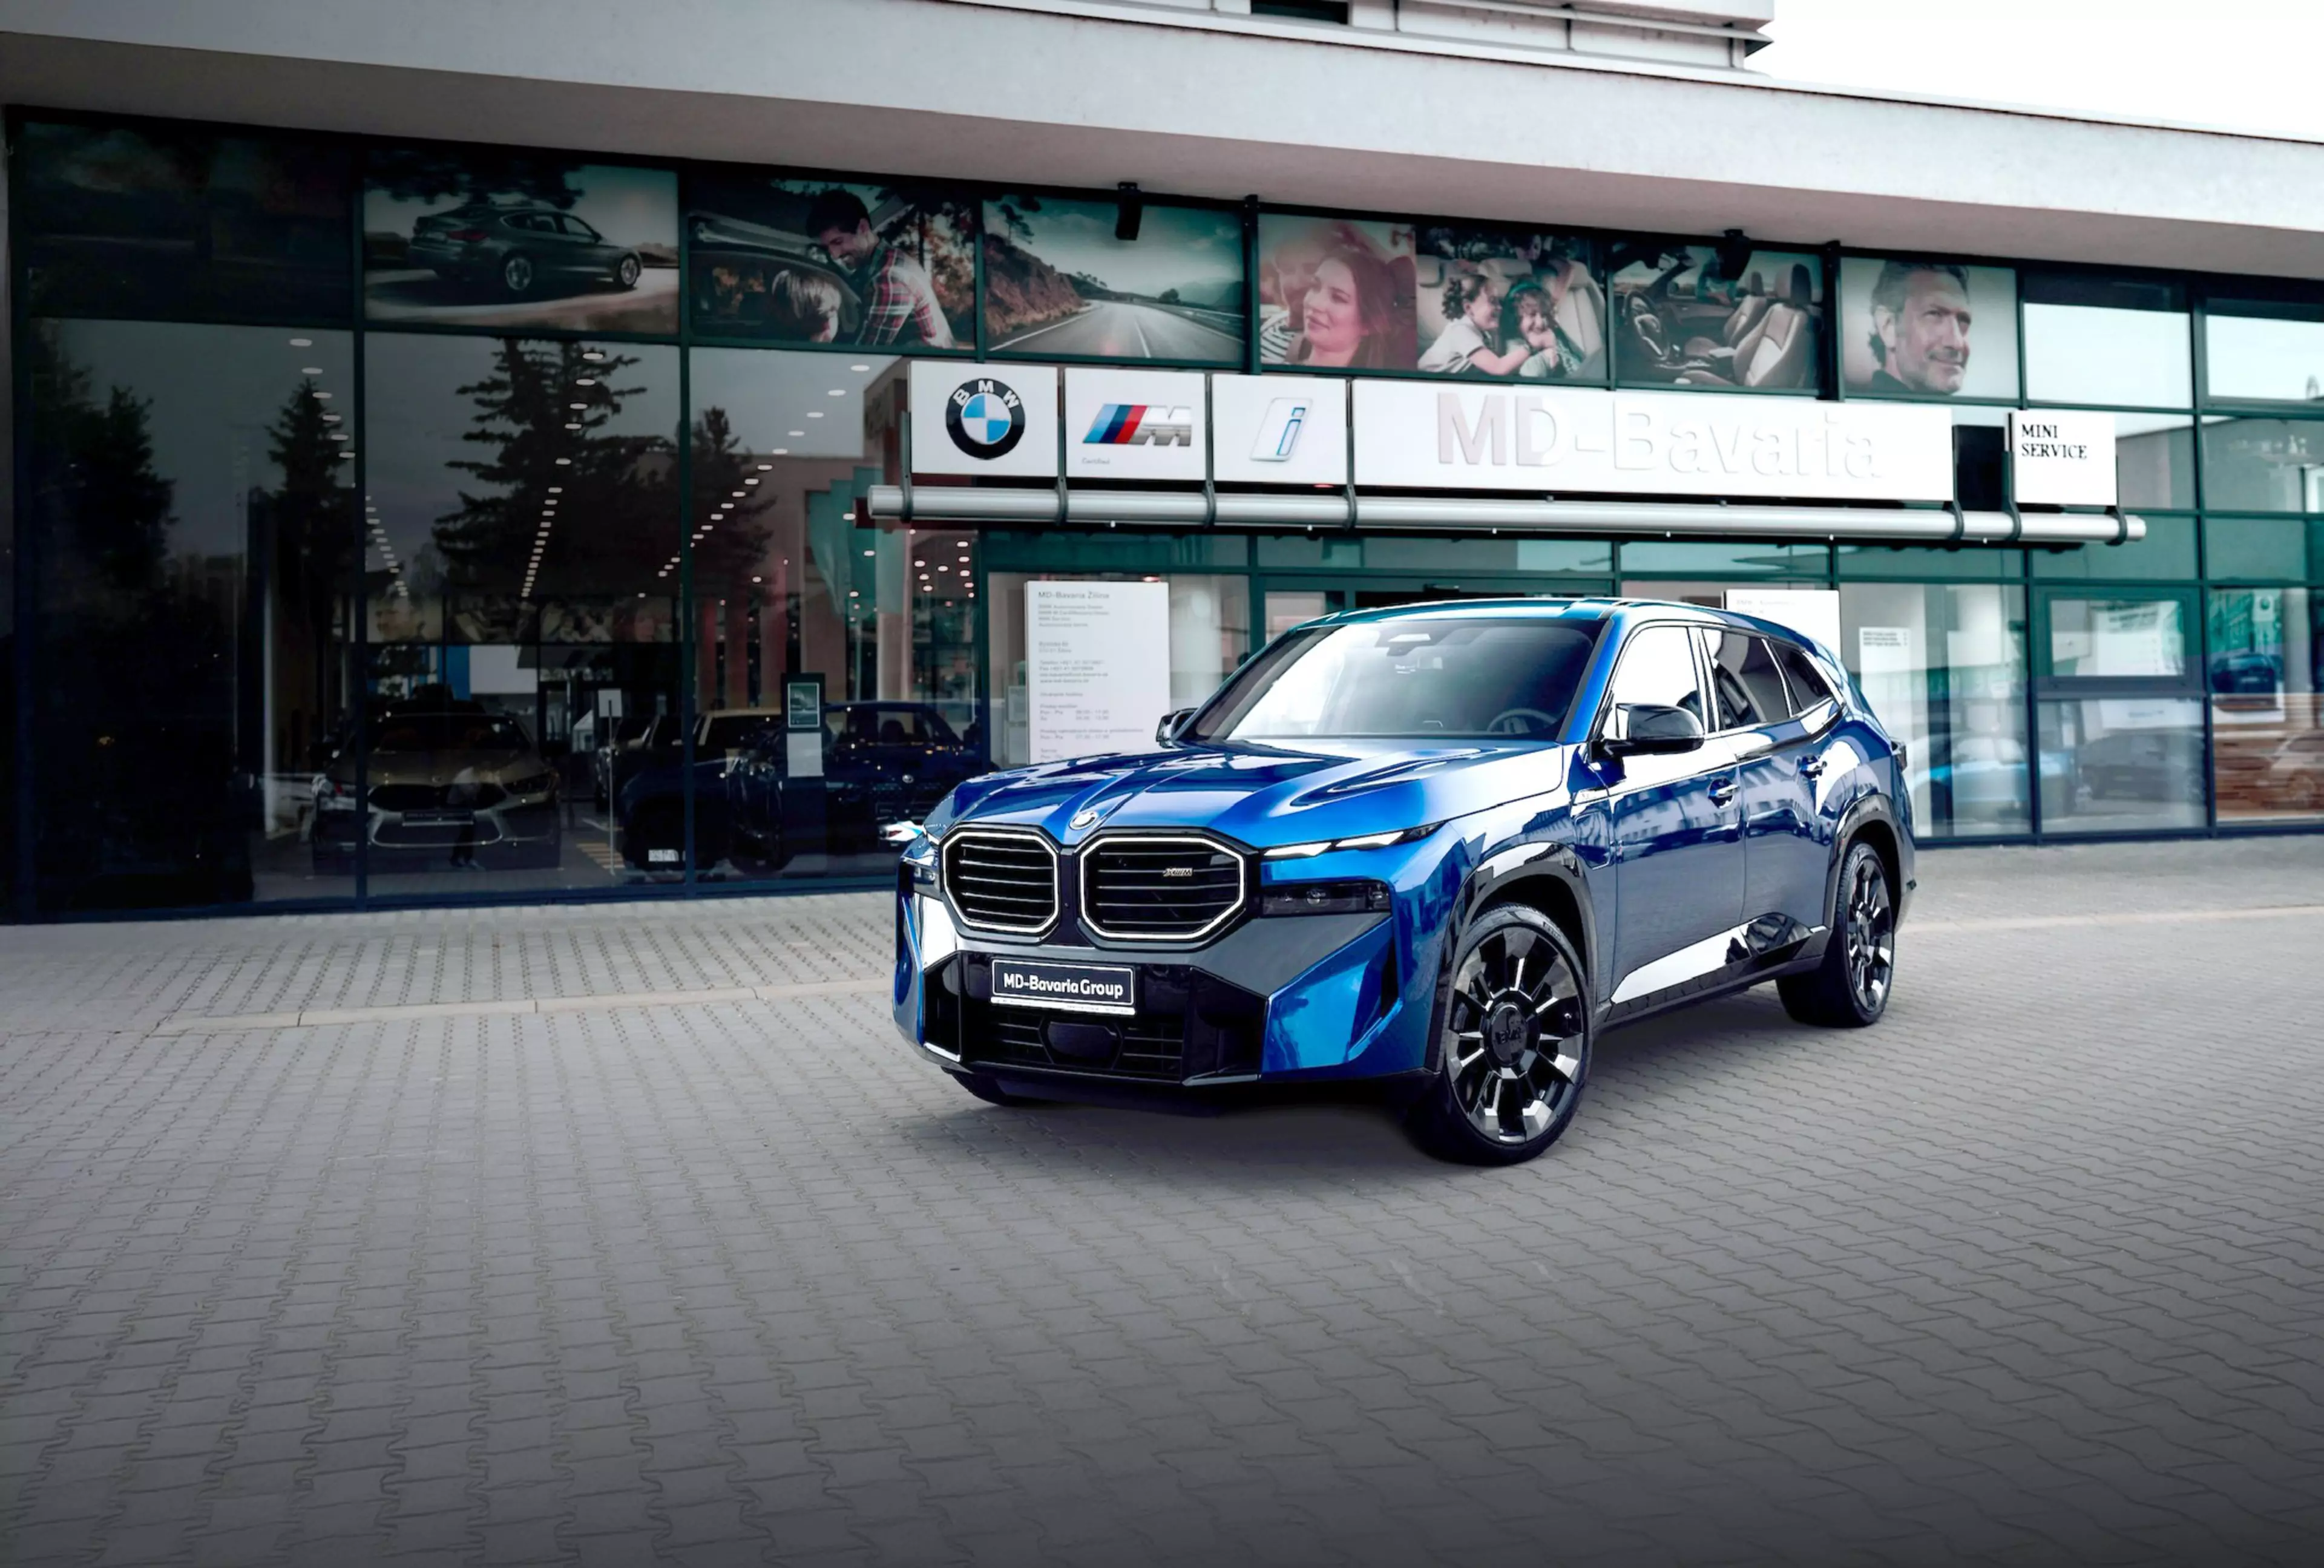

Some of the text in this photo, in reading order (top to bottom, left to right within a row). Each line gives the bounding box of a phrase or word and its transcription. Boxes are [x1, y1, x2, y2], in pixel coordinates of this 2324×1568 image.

[953, 379, 1019, 408] BMW
[1436, 392, 1884, 479] MD-Bavaria
[2021, 424, 2058, 439] MINI
[2021, 443, 2087, 460] SERVICE
[1003, 973, 1123, 999] MD-Bavaria Group
